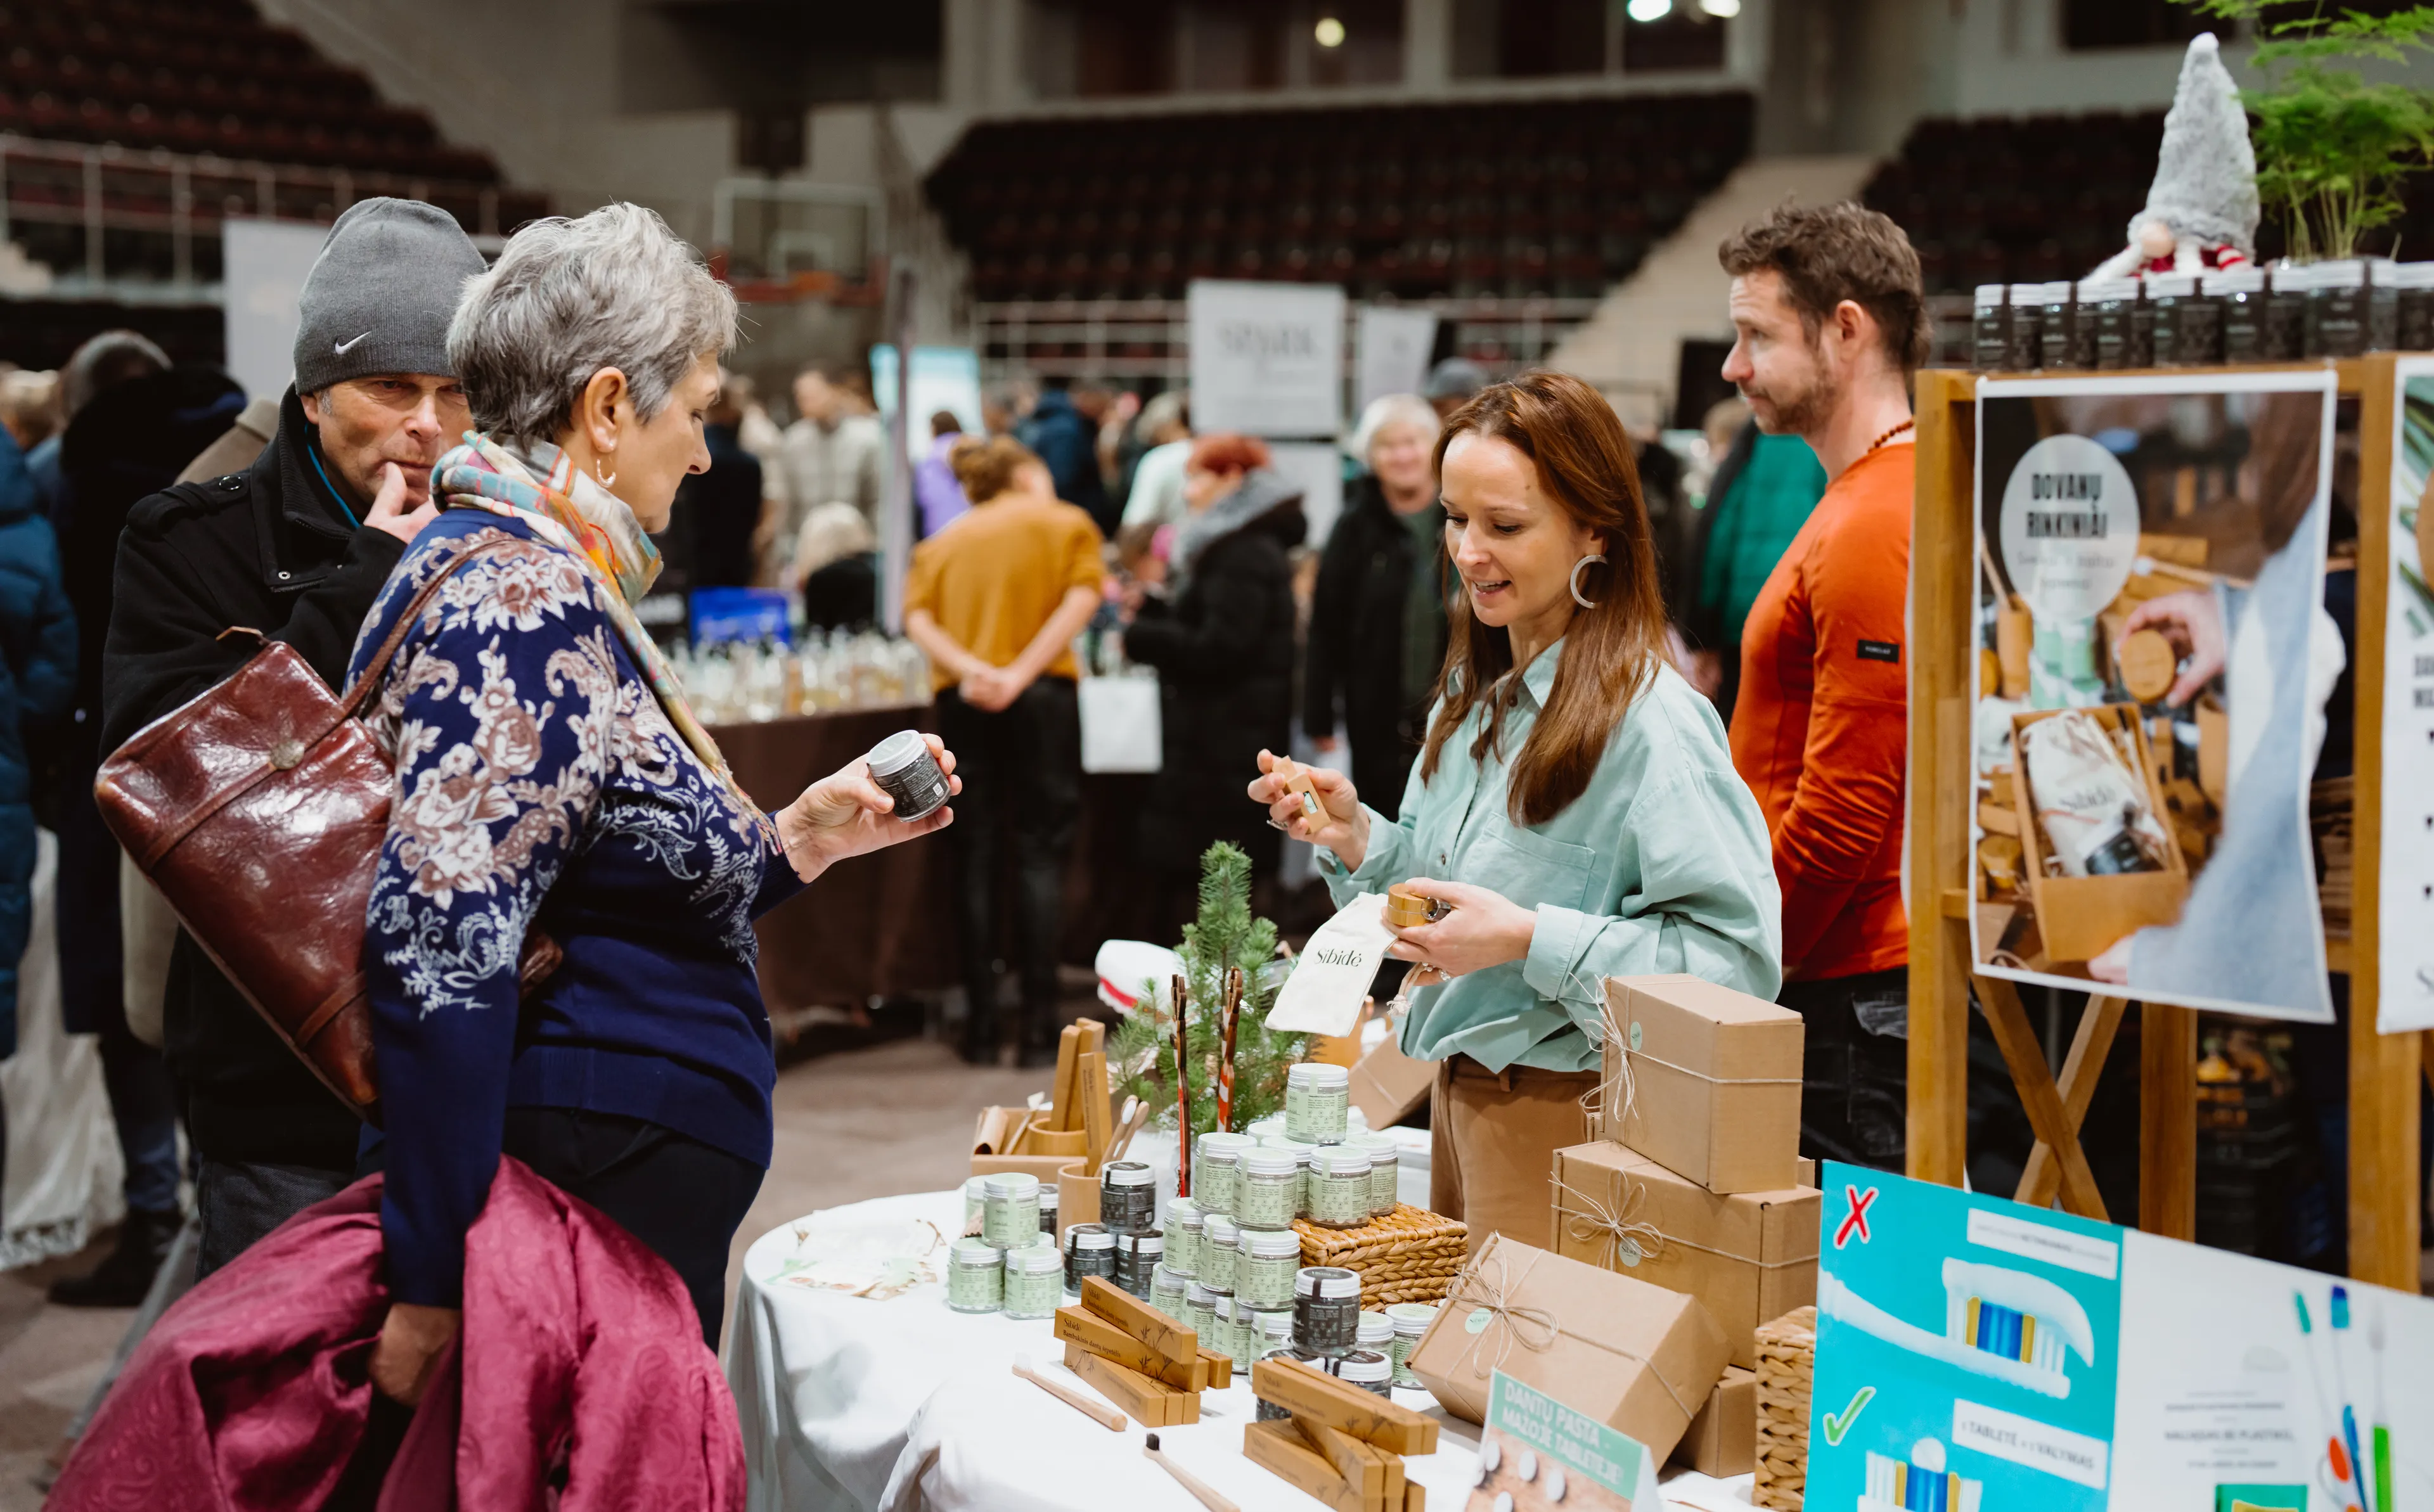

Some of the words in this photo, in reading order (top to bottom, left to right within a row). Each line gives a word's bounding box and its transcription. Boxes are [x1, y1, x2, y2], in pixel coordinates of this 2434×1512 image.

[2026, 511, 2108, 539] RINKINIAI
[1314, 948, 1363, 968] Sibidė
[1064, 1317, 1082, 1332] Sibidė
[1063, 1329, 1088, 1344] Bambukinis
[1555, 1407, 1600, 1449] PASTA
